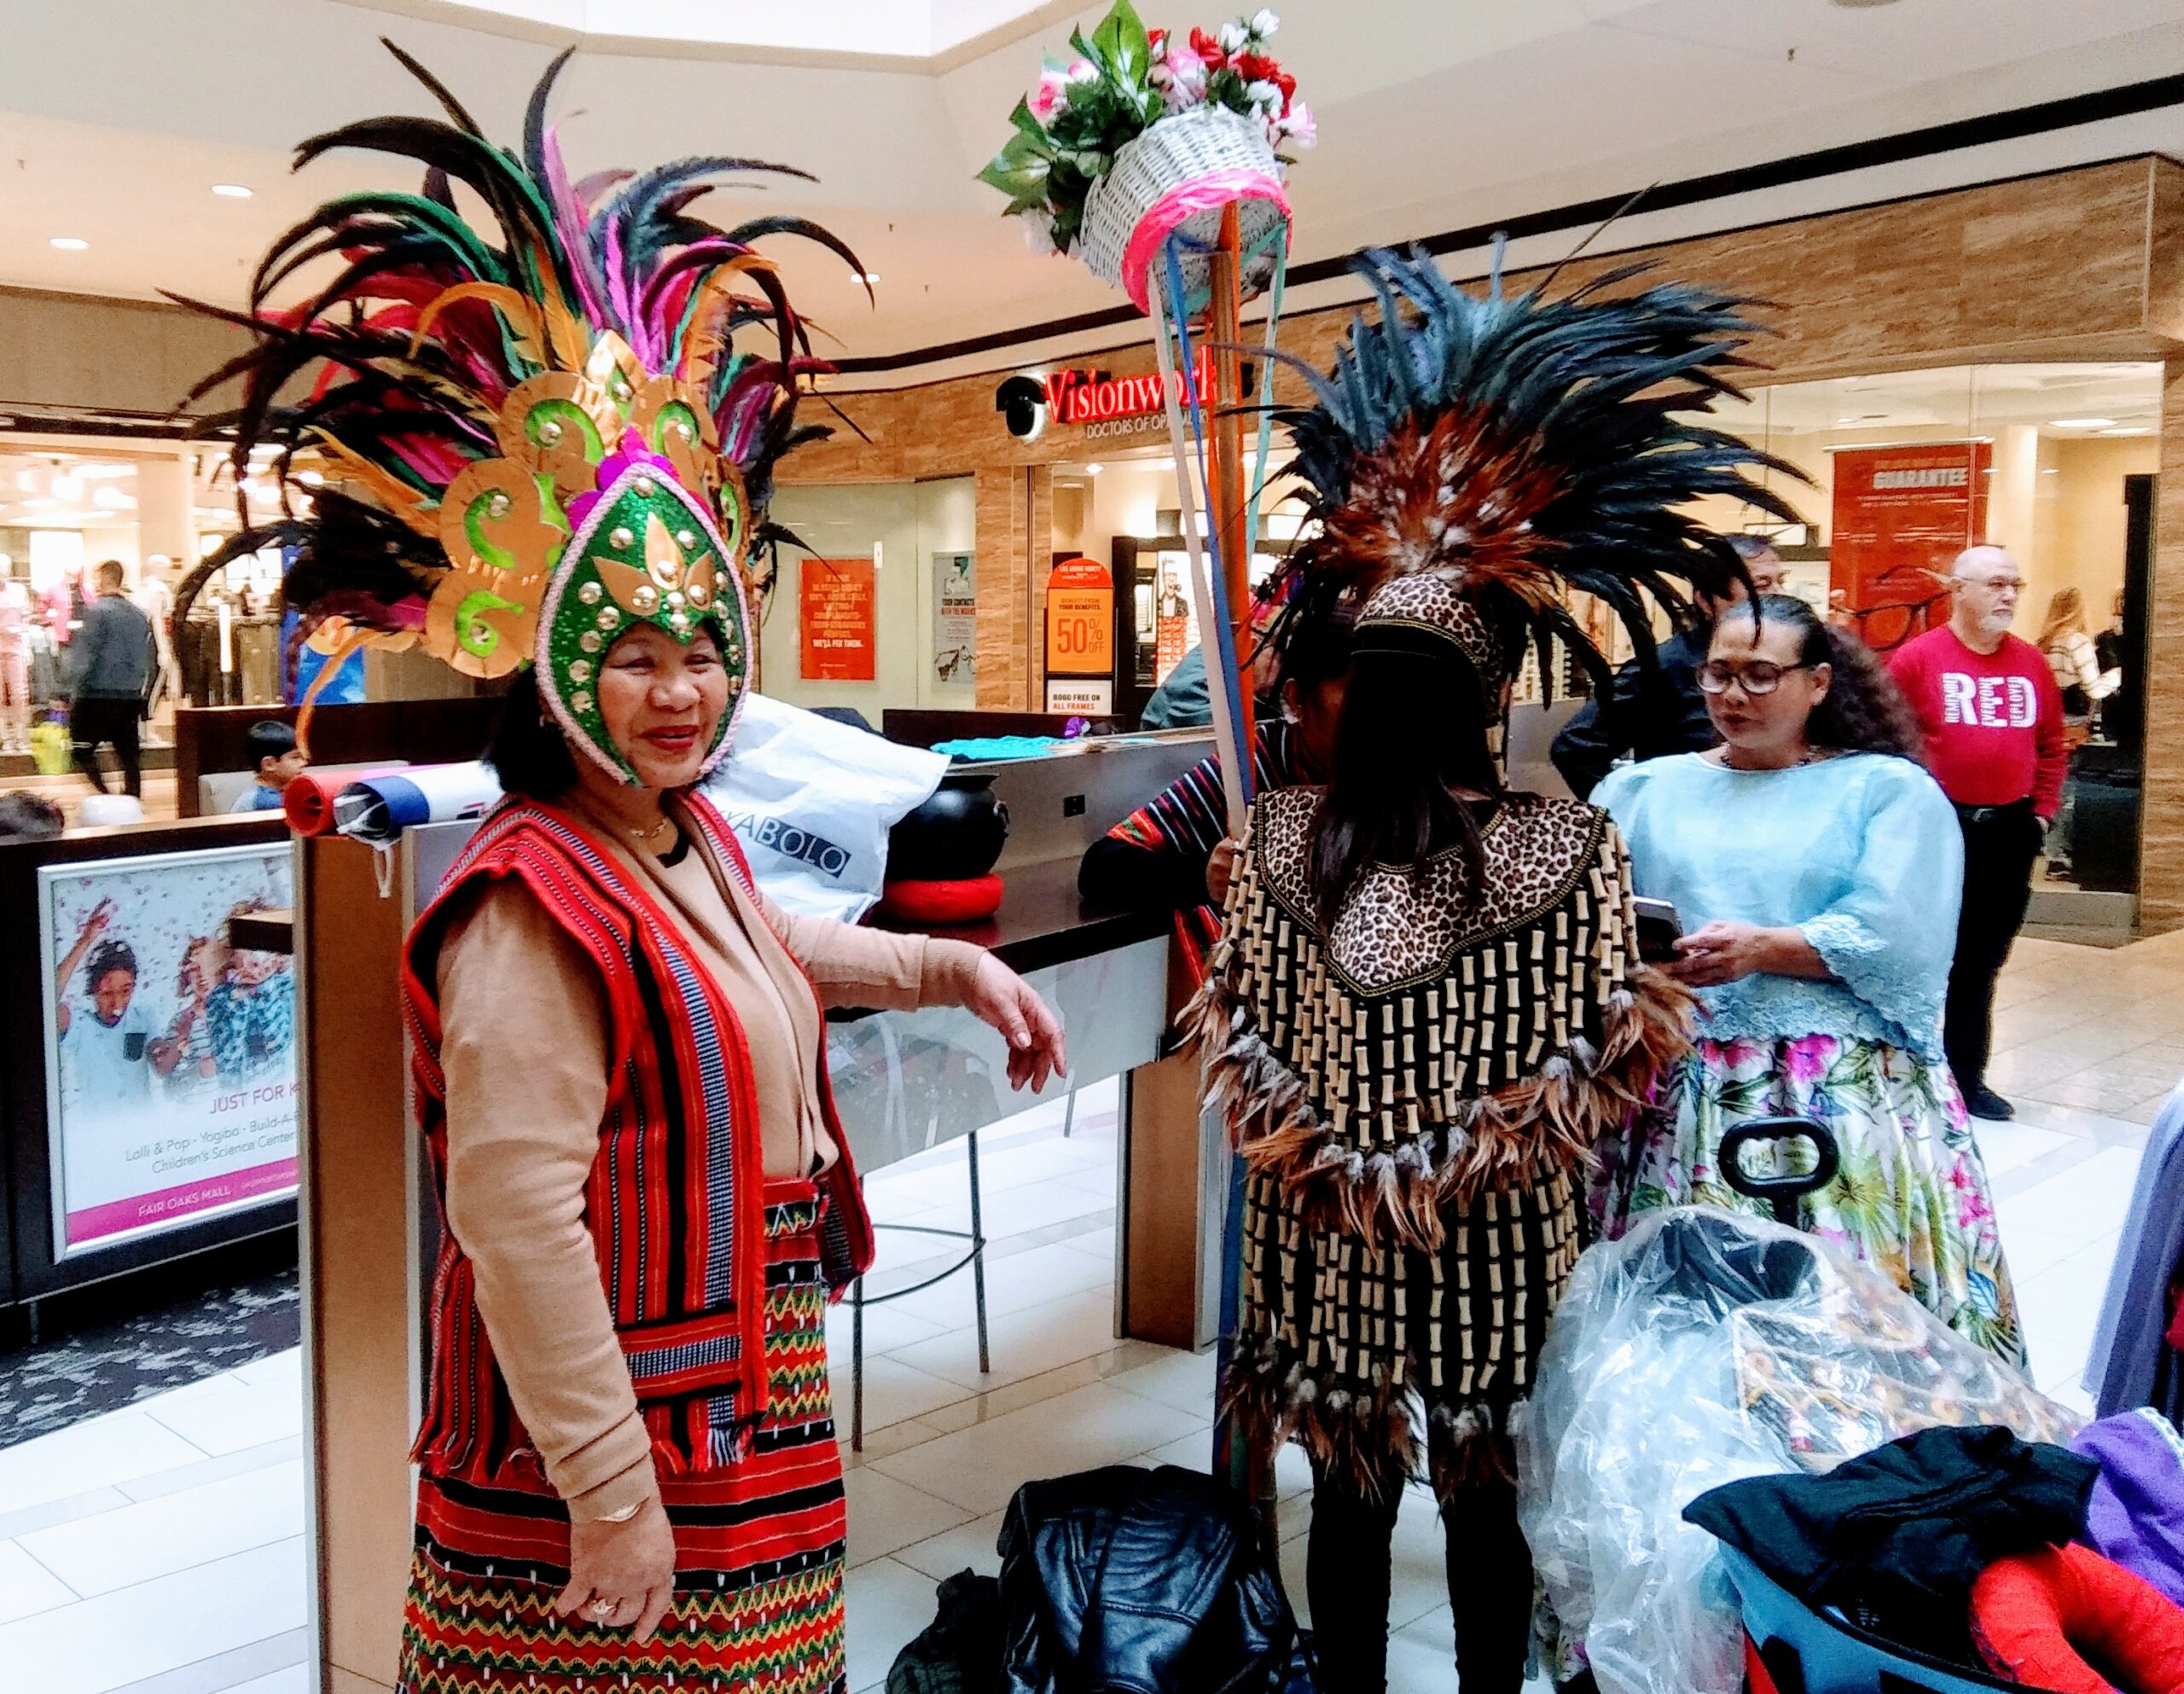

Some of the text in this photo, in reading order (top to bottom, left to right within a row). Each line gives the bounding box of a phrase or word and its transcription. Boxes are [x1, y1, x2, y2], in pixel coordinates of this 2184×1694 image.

[1086, 419, 1134, 440] DOCTORS
[1135, 415, 1150, 432] OF
[1089, 641, 1106, 654] OFF
[1067, 702, 1095, 711] FRAMES
[1942, 671, 2037, 728] RED
[720, 810, 850, 876] YABOLO
[209, 1092, 248, 1115] JUST
[253, 1084, 284, 1105] FOR
[152, 1131, 296, 1175] Children's Science Center
[154, 1142, 164, 1156] &
[167, 1137, 191, 1153] Pop
[200, 1127, 241, 1145] Yogibo
[138, 1185, 233, 1217] FAIR OAKS MALL
